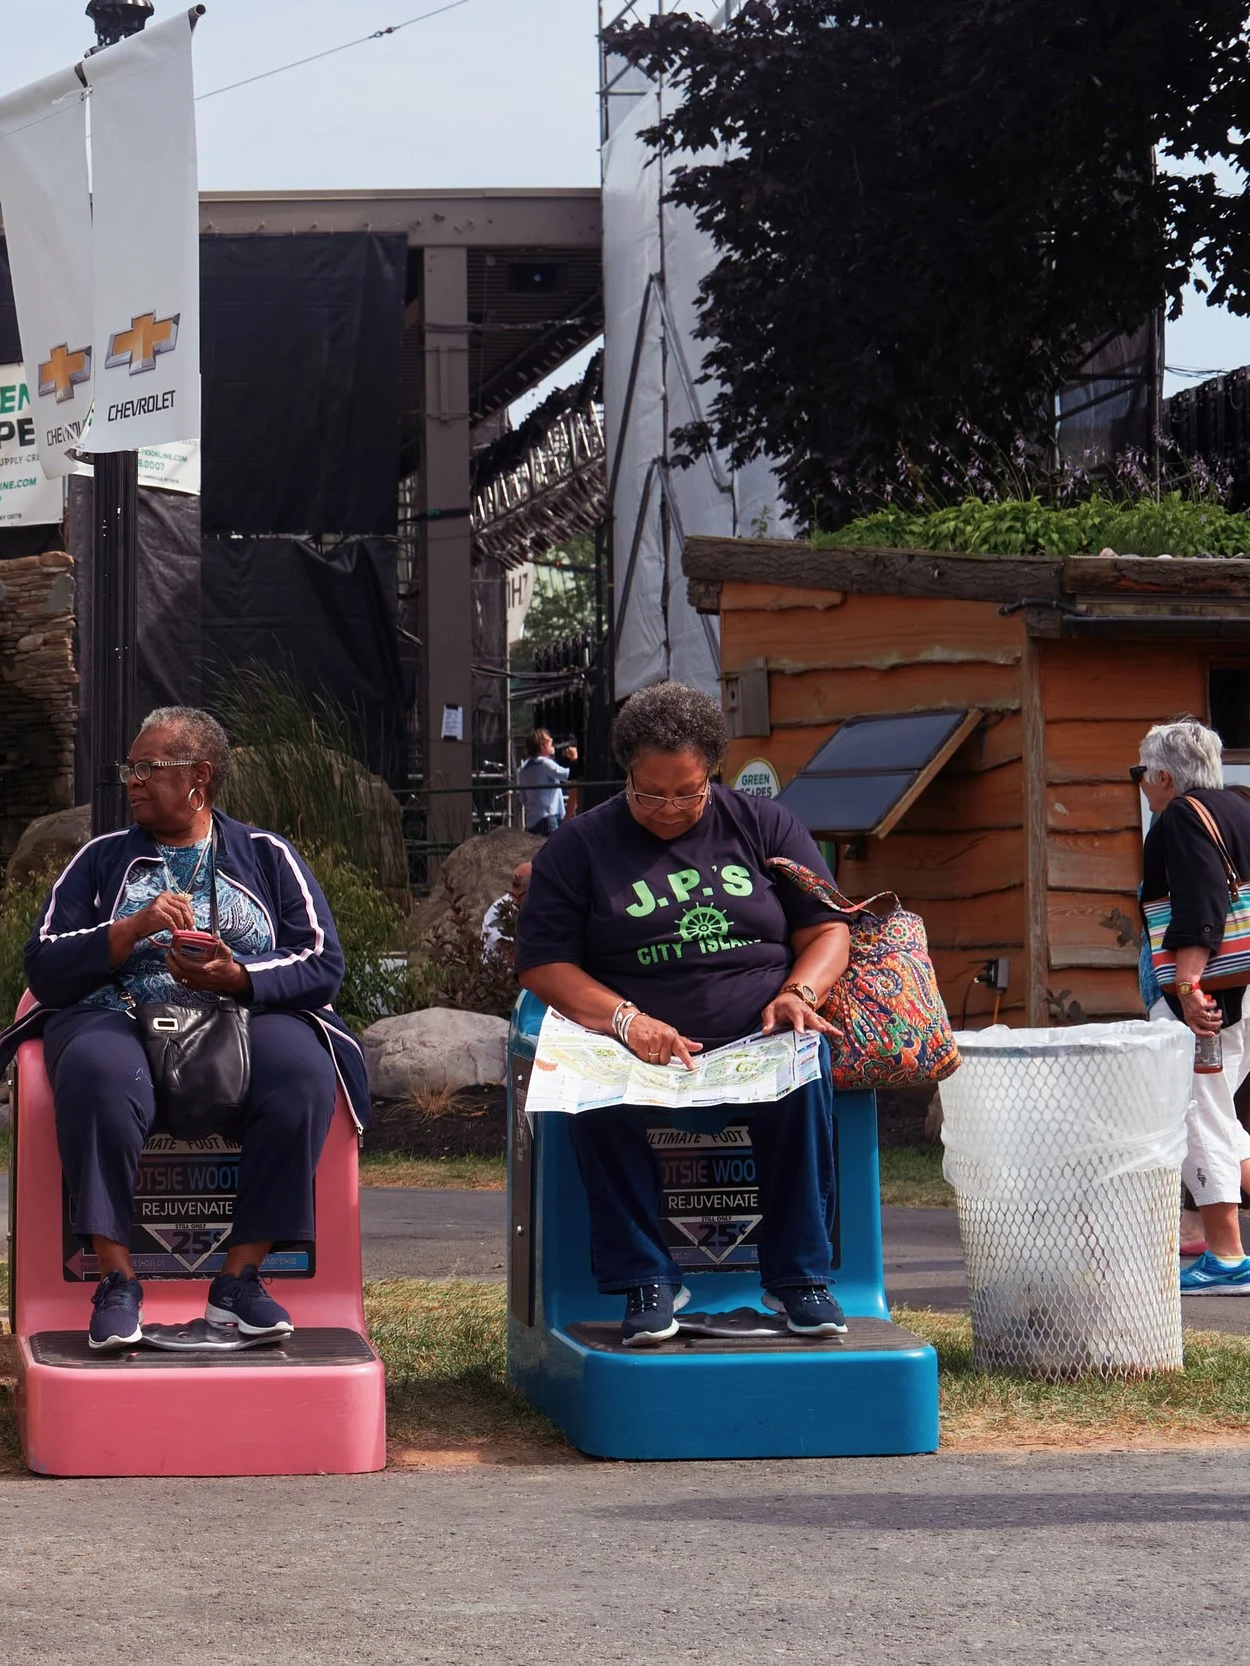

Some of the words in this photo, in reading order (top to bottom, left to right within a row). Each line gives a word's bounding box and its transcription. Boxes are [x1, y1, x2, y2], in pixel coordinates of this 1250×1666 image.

[108, 390, 176, 422] CHEVROLET
[741, 773, 770, 786] GREEN
[625, 865, 754, 918] J.P.'S
[637, 943, 683, 966] CITY
[187, 1166, 239, 1190] WOOT
[142, 1201, 233, 1216] REJUVENATE
[668, 1193, 758, 1209] REJUVENATE
